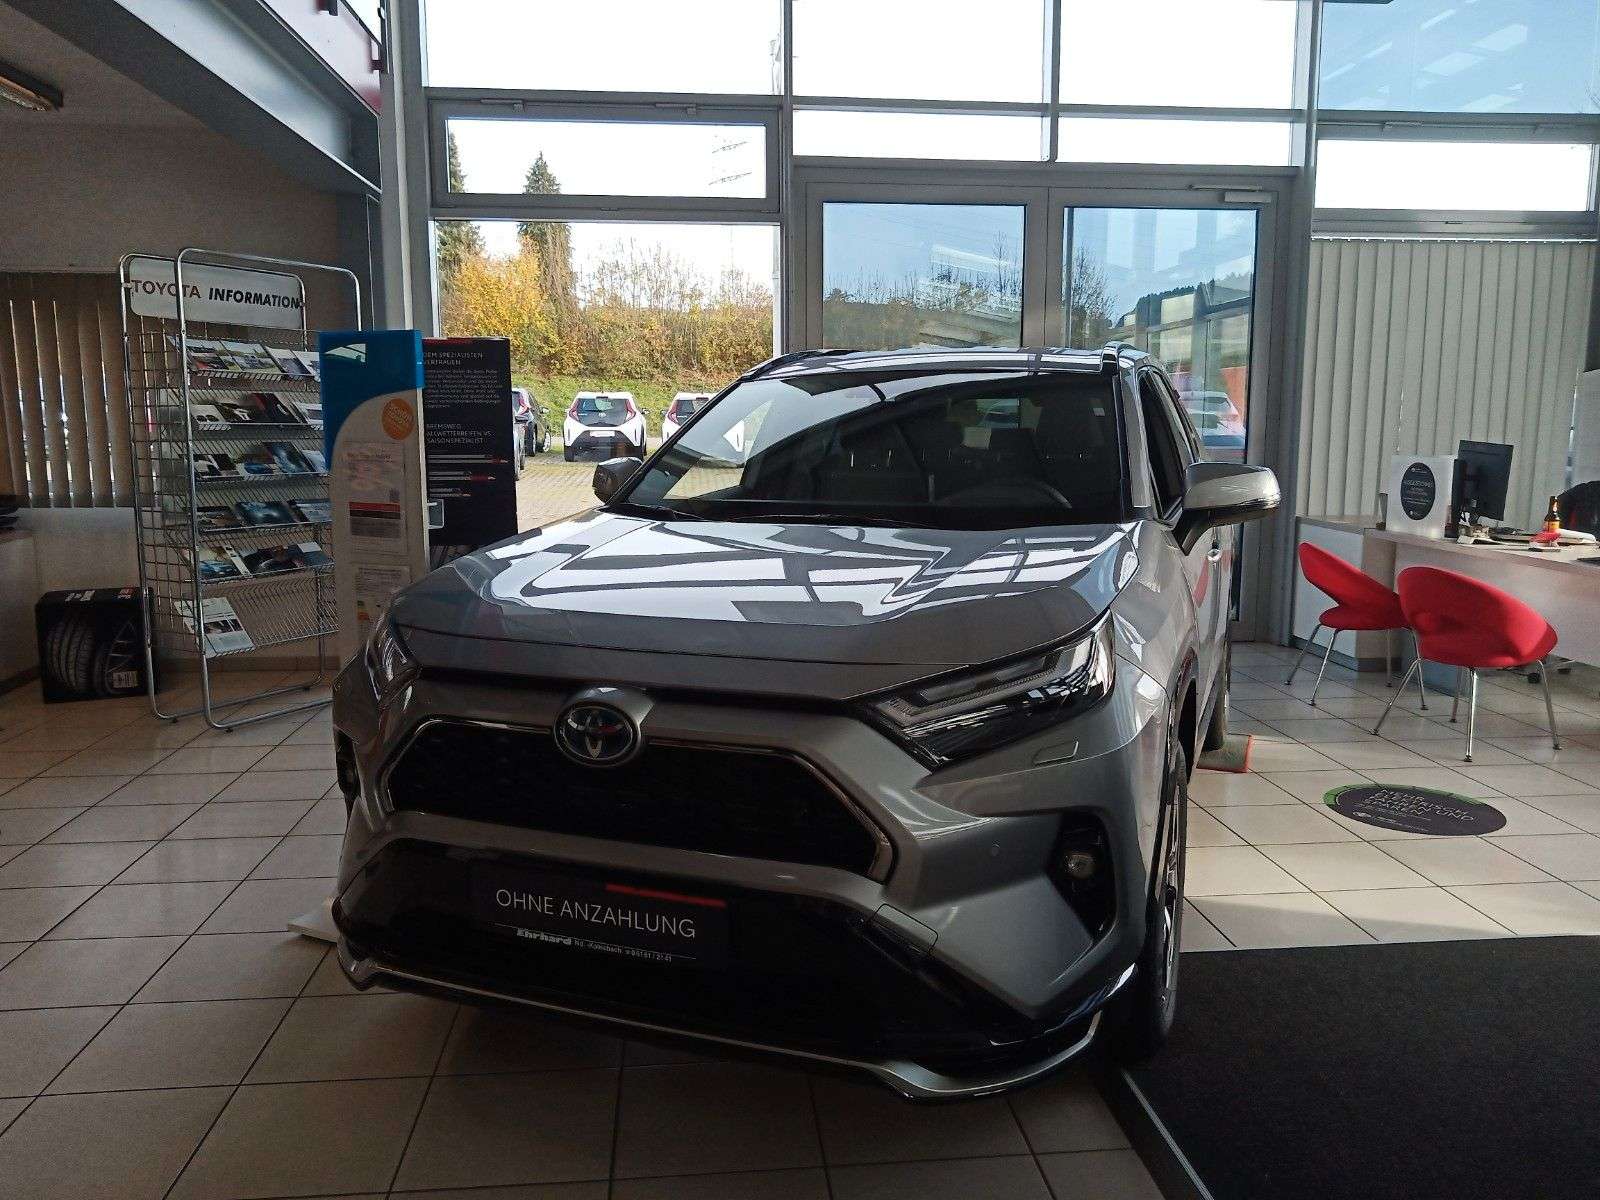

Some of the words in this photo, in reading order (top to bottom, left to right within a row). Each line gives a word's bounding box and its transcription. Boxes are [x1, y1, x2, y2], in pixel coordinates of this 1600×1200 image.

[131, 279, 202, 299] TOYOTA
[208, 287, 301, 309] INFORMATION
[496, 889, 554, 915] OHNE
[560, 900, 696, 938] ANZAHLUNG
[516, 928, 572, 945] Ehrhard
